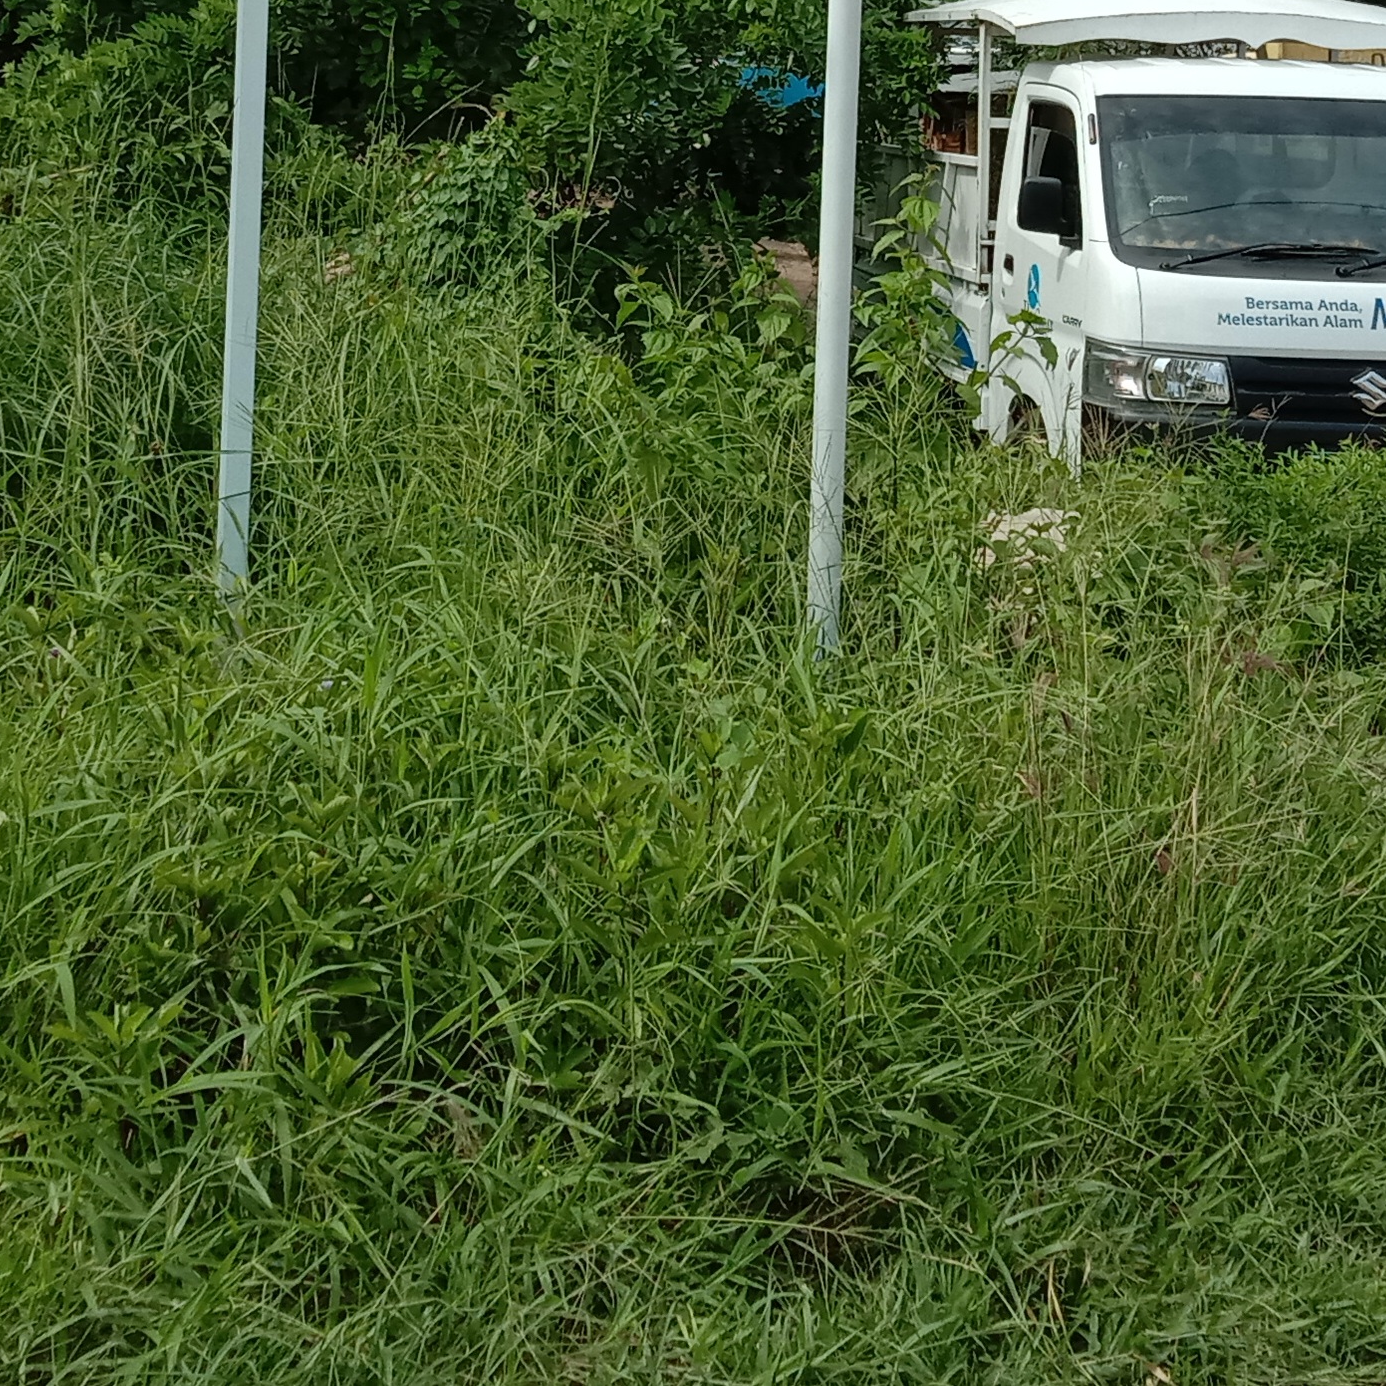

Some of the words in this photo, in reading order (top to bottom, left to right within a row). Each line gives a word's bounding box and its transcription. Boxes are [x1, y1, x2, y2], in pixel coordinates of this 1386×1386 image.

[1244, 296, 1314, 311] Bersama
[1317, 299, 1363, 314] Anda,
[1216, 313, 1319, 328] Melestarikan
[1322, 314, 1364, 329] Alam
